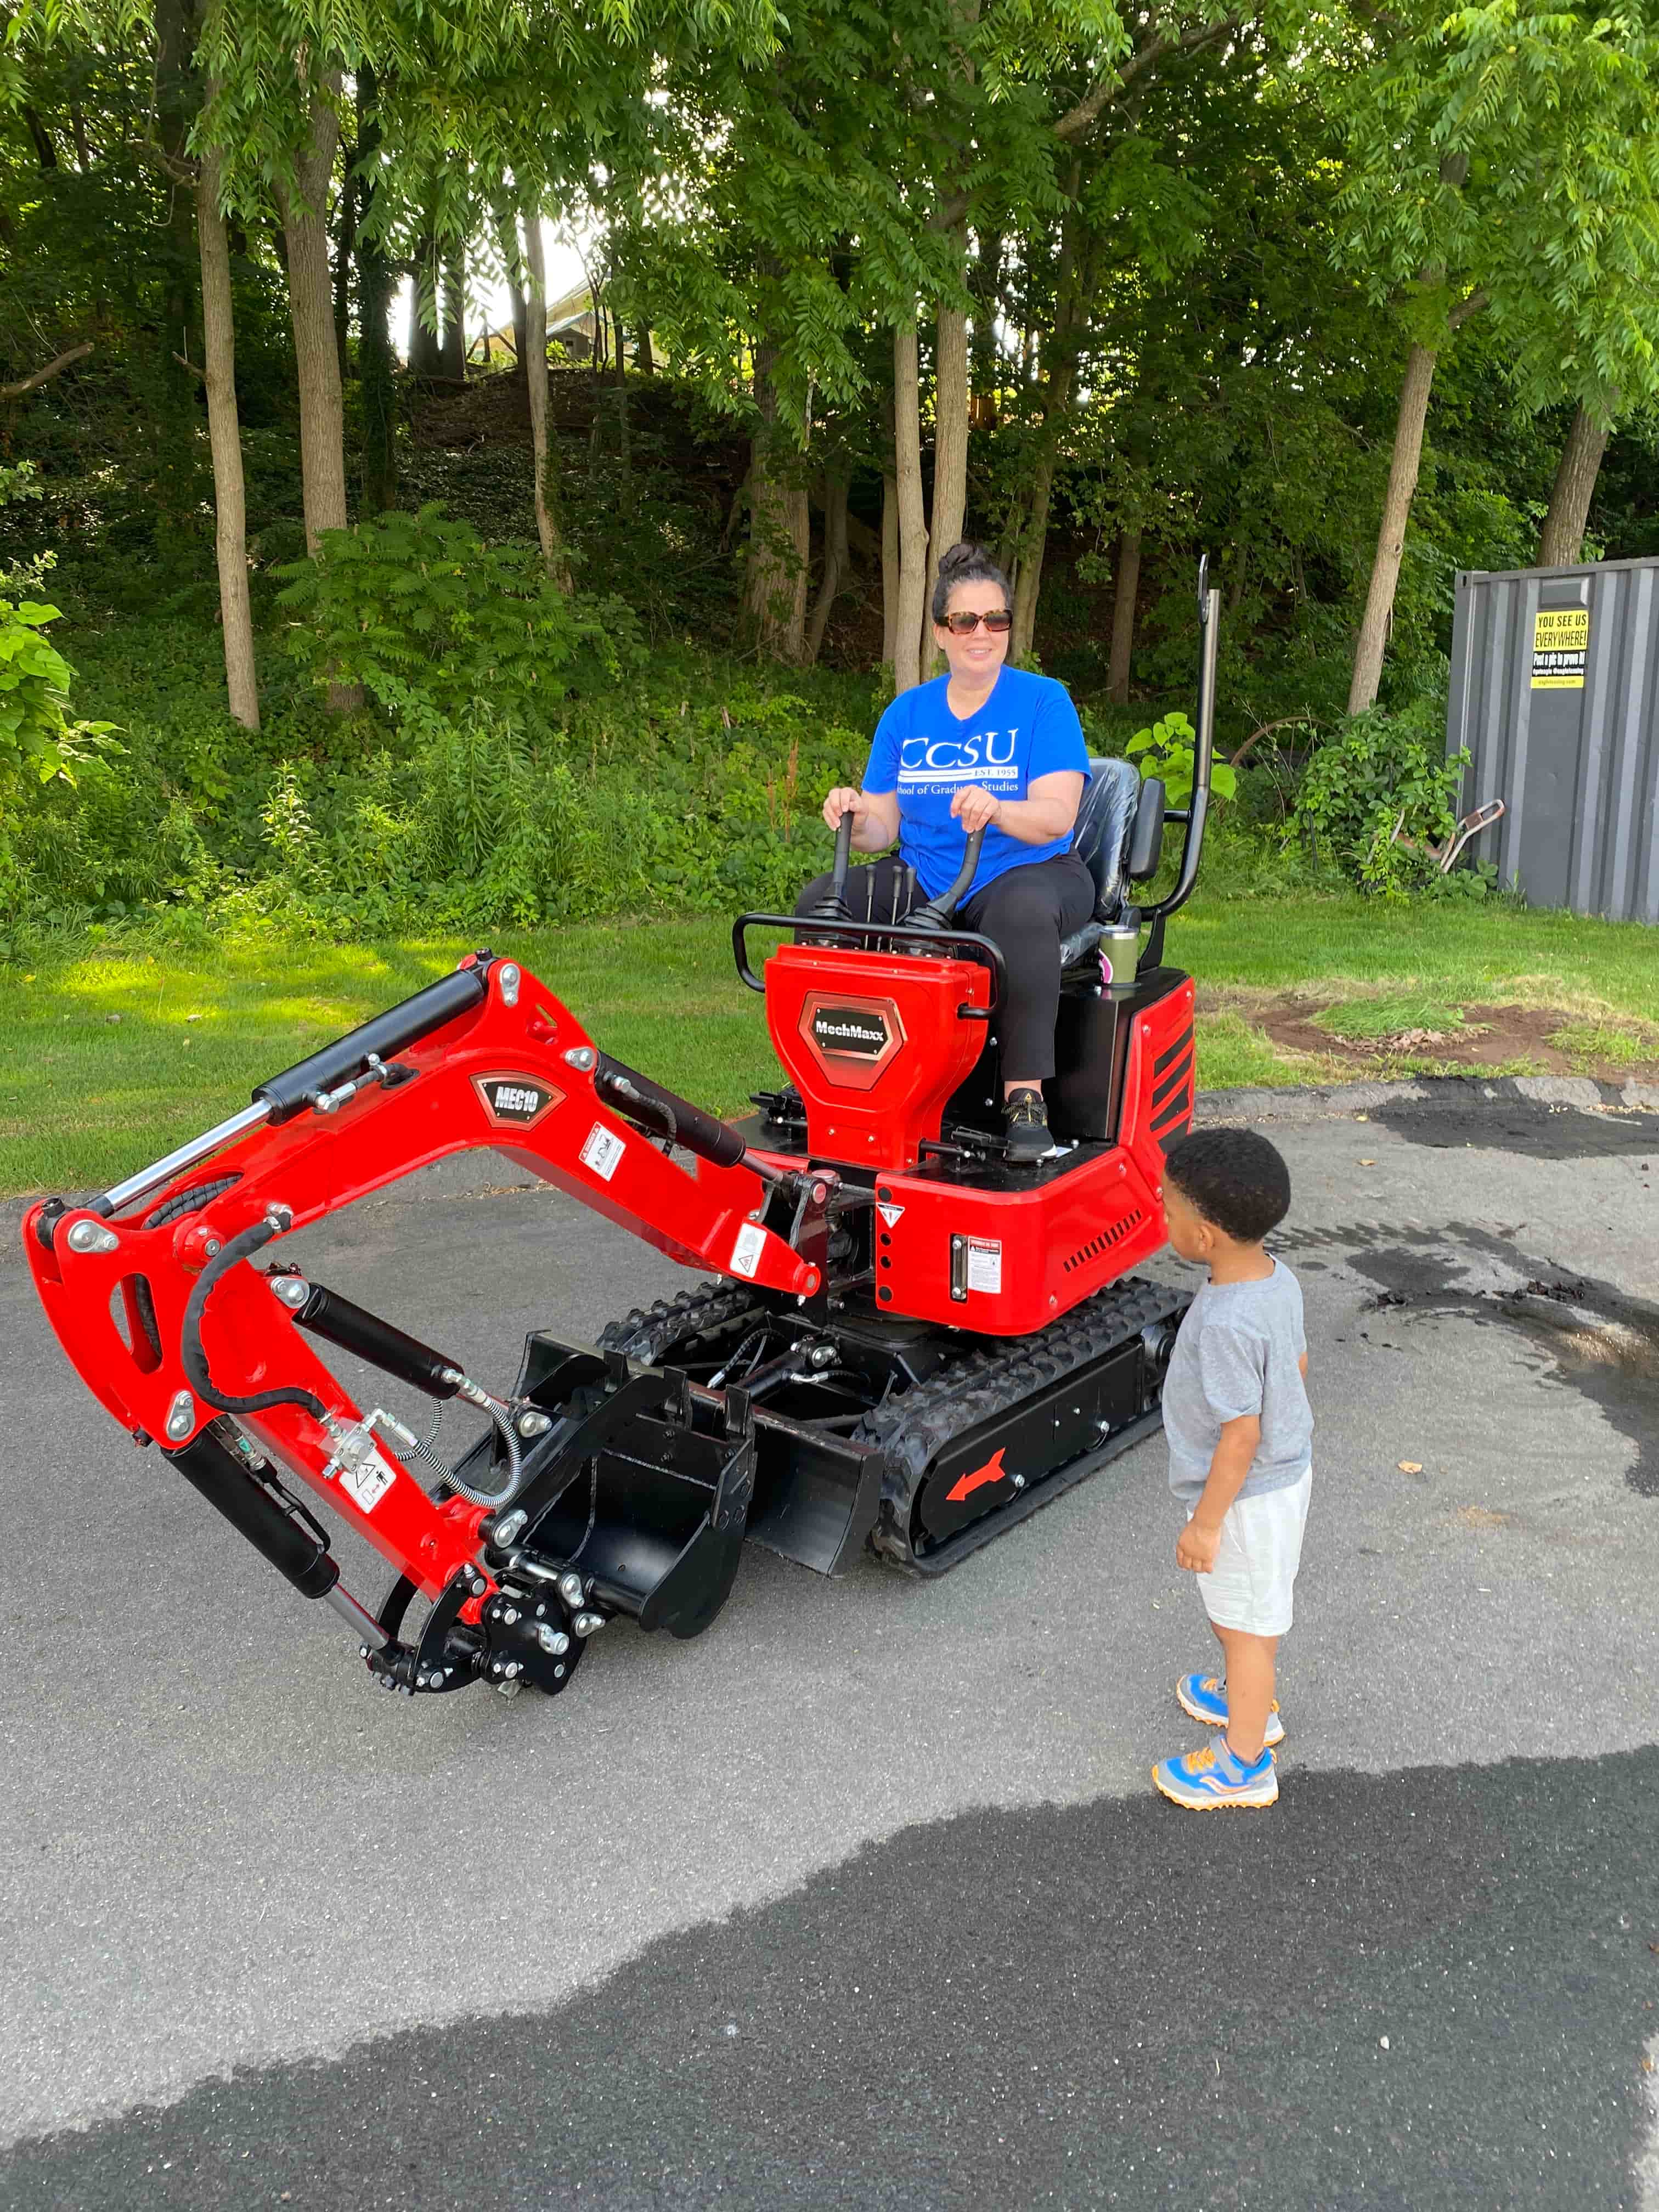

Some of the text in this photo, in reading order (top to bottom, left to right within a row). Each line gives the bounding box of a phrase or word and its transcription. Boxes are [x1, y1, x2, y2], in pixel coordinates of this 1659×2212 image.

[1538, 614, 1587, 628] YOU SEE US
[1536, 630, 1587, 647] EVERYWHERE!
[900, 728, 1019, 769] CCSU
[997, 769, 1016, 777] 1955
[917, 784, 930, 794] of
[981, 781, 1019, 791] Studies
[816, 1020, 883, 1041] MechMaxx
[495, 1086, 538, 1112] MEC10
